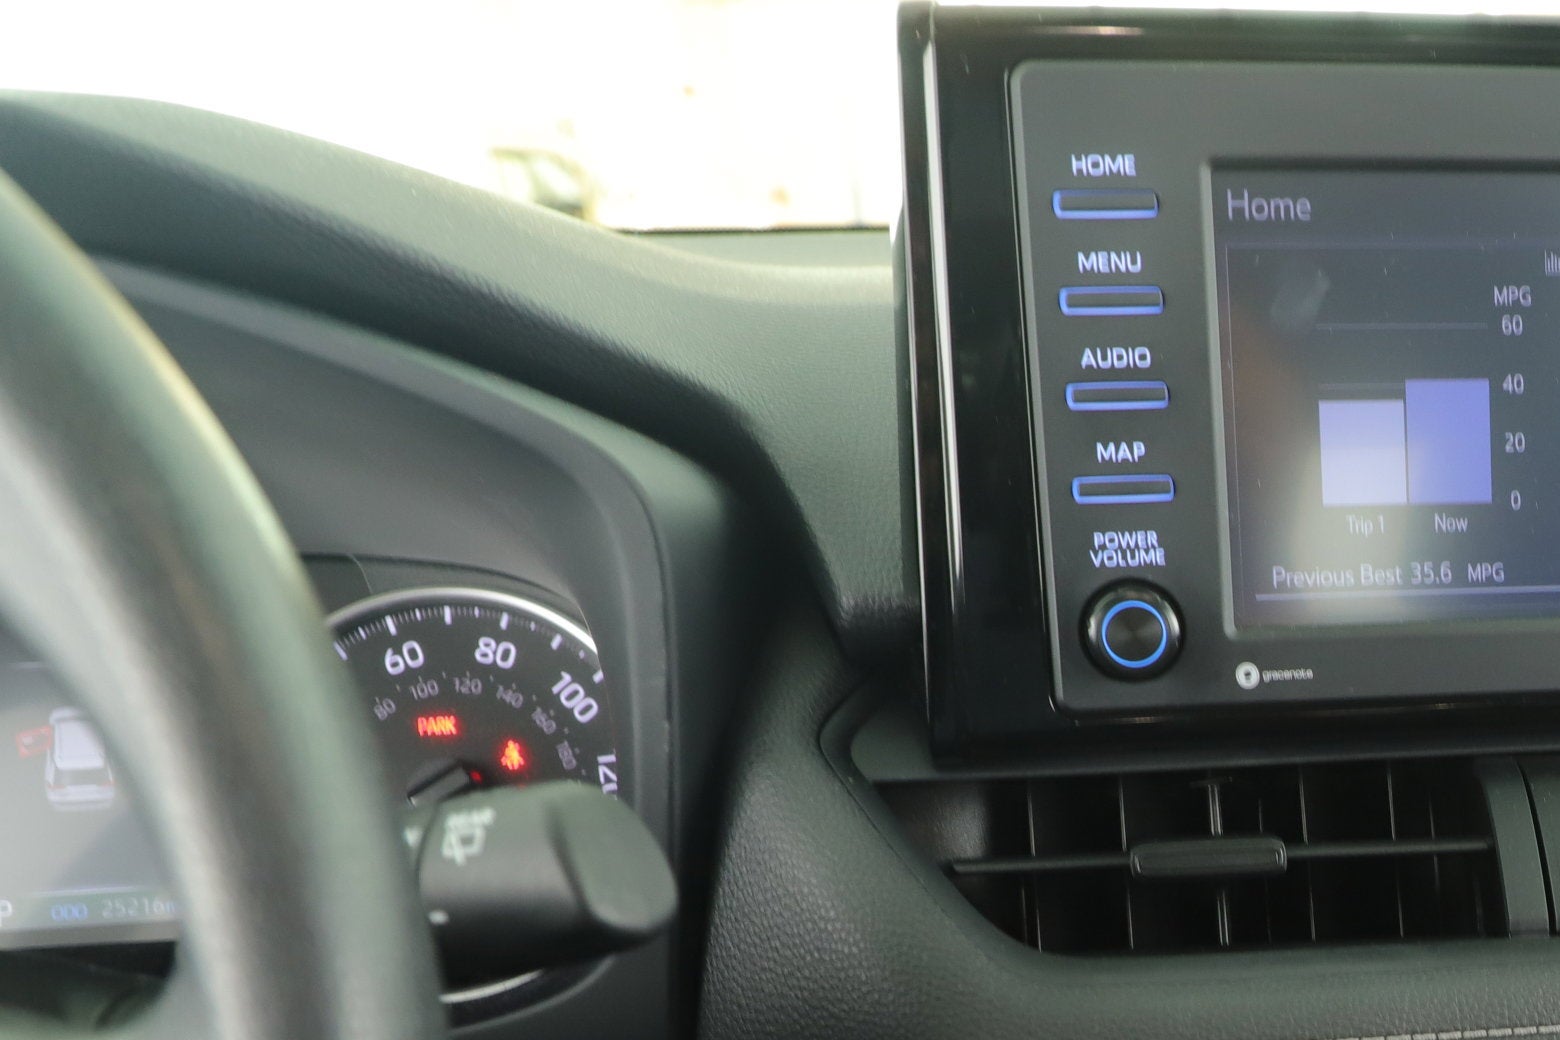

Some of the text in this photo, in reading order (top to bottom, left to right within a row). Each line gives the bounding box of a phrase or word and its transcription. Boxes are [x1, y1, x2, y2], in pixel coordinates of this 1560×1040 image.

[1071, 154, 1137, 177] HOME
[1226, 189, 1312, 221] Home
[1078, 251, 1142, 273] MENU
[1493, 285, 1533, 307] MPG
[1501, 315, 1523, 336] 60
[1081, 347, 1151, 369] AUDIO
[1502, 373, 1525, 395] 40
[1096, 441, 1147, 464] MAP
[1504, 432, 1526, 454] 20
[1511, 490, 1522, 511] 0
[1346, 514, 1386, 536] Trip 1
[1434, 513, 1469, 533] Now
[1093, 530, 1159, 549] POWER
[1089, 548, 1166, 568] VOLUME
[1272, 561, 1505, 590] Previous Best 35.6 MPG
[384, 640, 425, 675] 60
[474, 637, 517, 669] 80
[551, 670, 599, 724] 100
[417, 715, 458, 737] PARK
